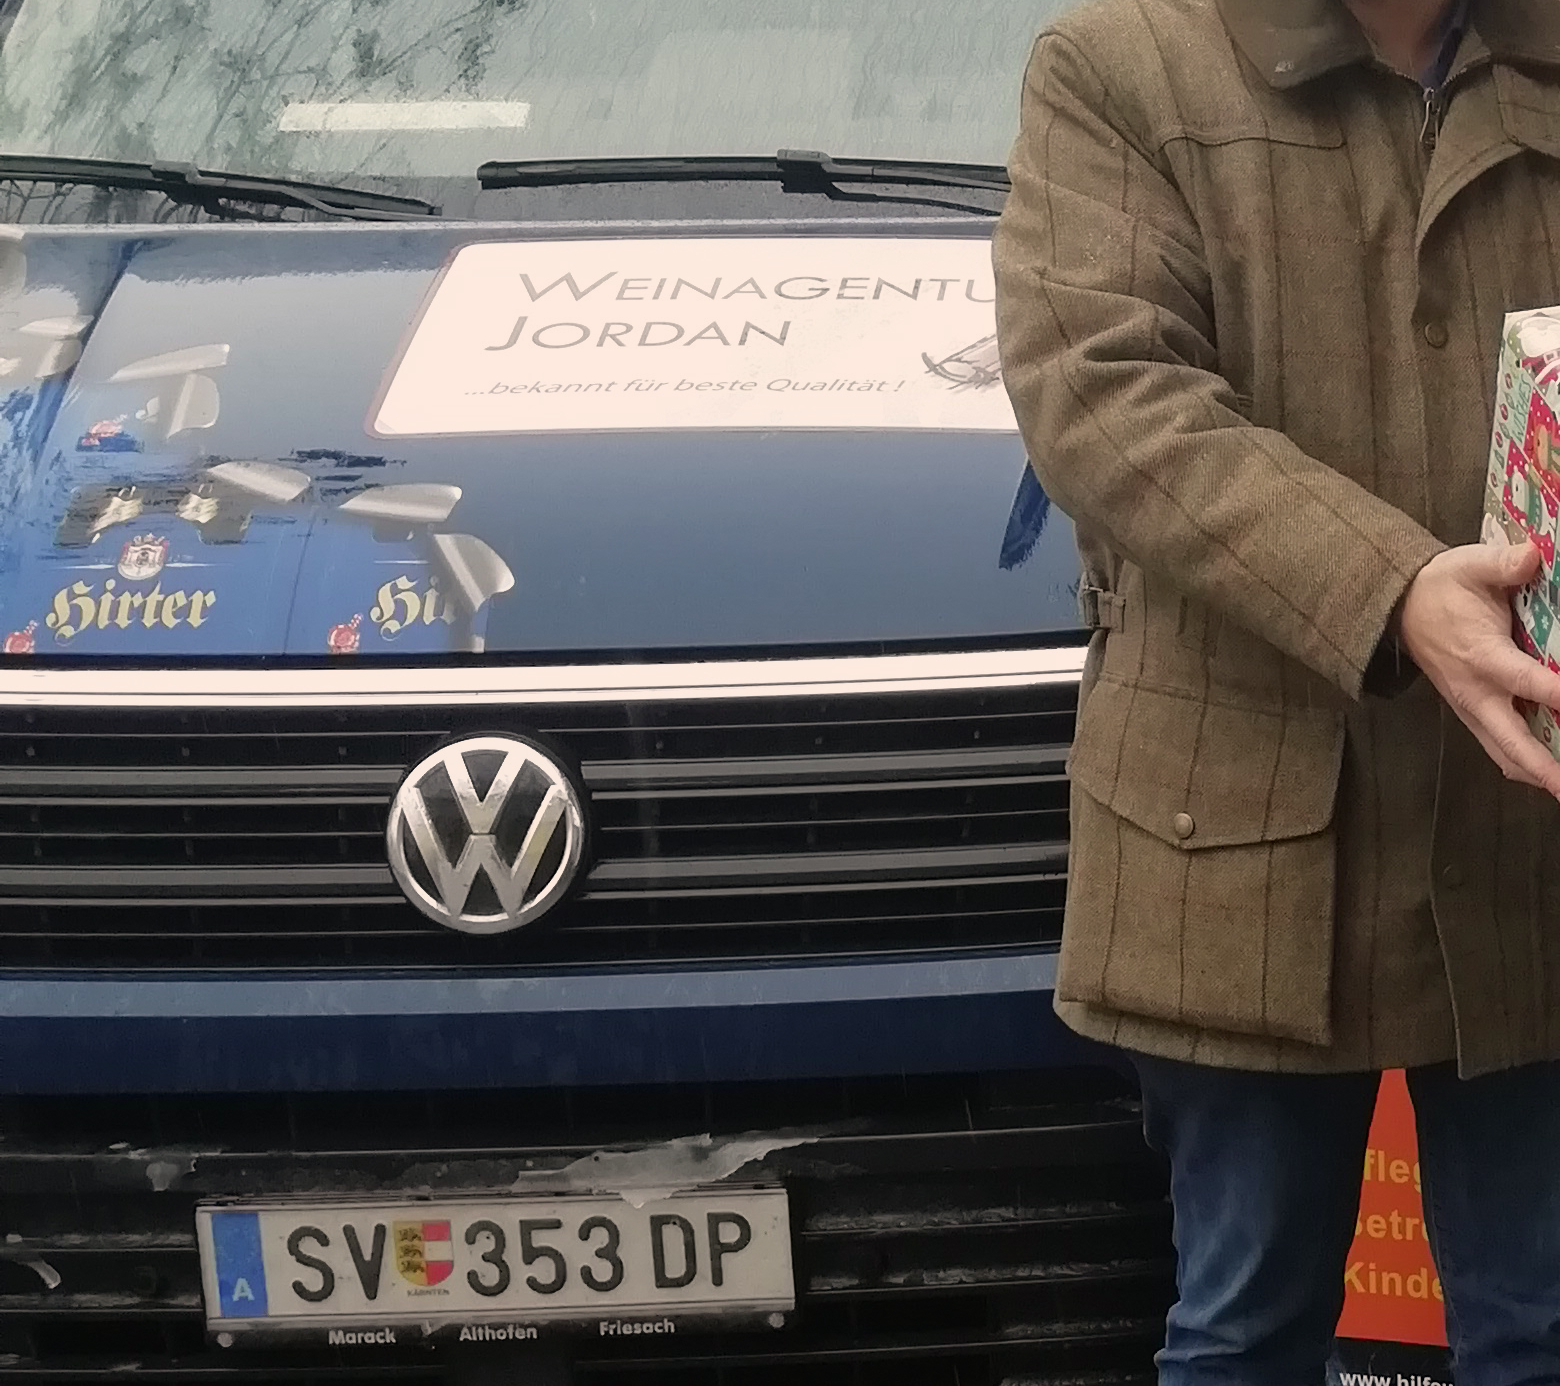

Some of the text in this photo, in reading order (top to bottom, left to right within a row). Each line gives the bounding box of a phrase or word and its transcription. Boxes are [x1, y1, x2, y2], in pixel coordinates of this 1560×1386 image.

[484, 315, 791, 352] JORDAN
[622, 377, 667, 394] für
[674, 377, 758, 394] beste
[766, 377, 889, 394] Qualität
[1512, 372, 1534, 443] WISHES
[45, 578, 217, 646] Hirter
[286, 1222, 387, 1303] SV
[231, 1278, 255, 1303] A
[327, 1317, 676, 1345] Marack Althofen Friesach
